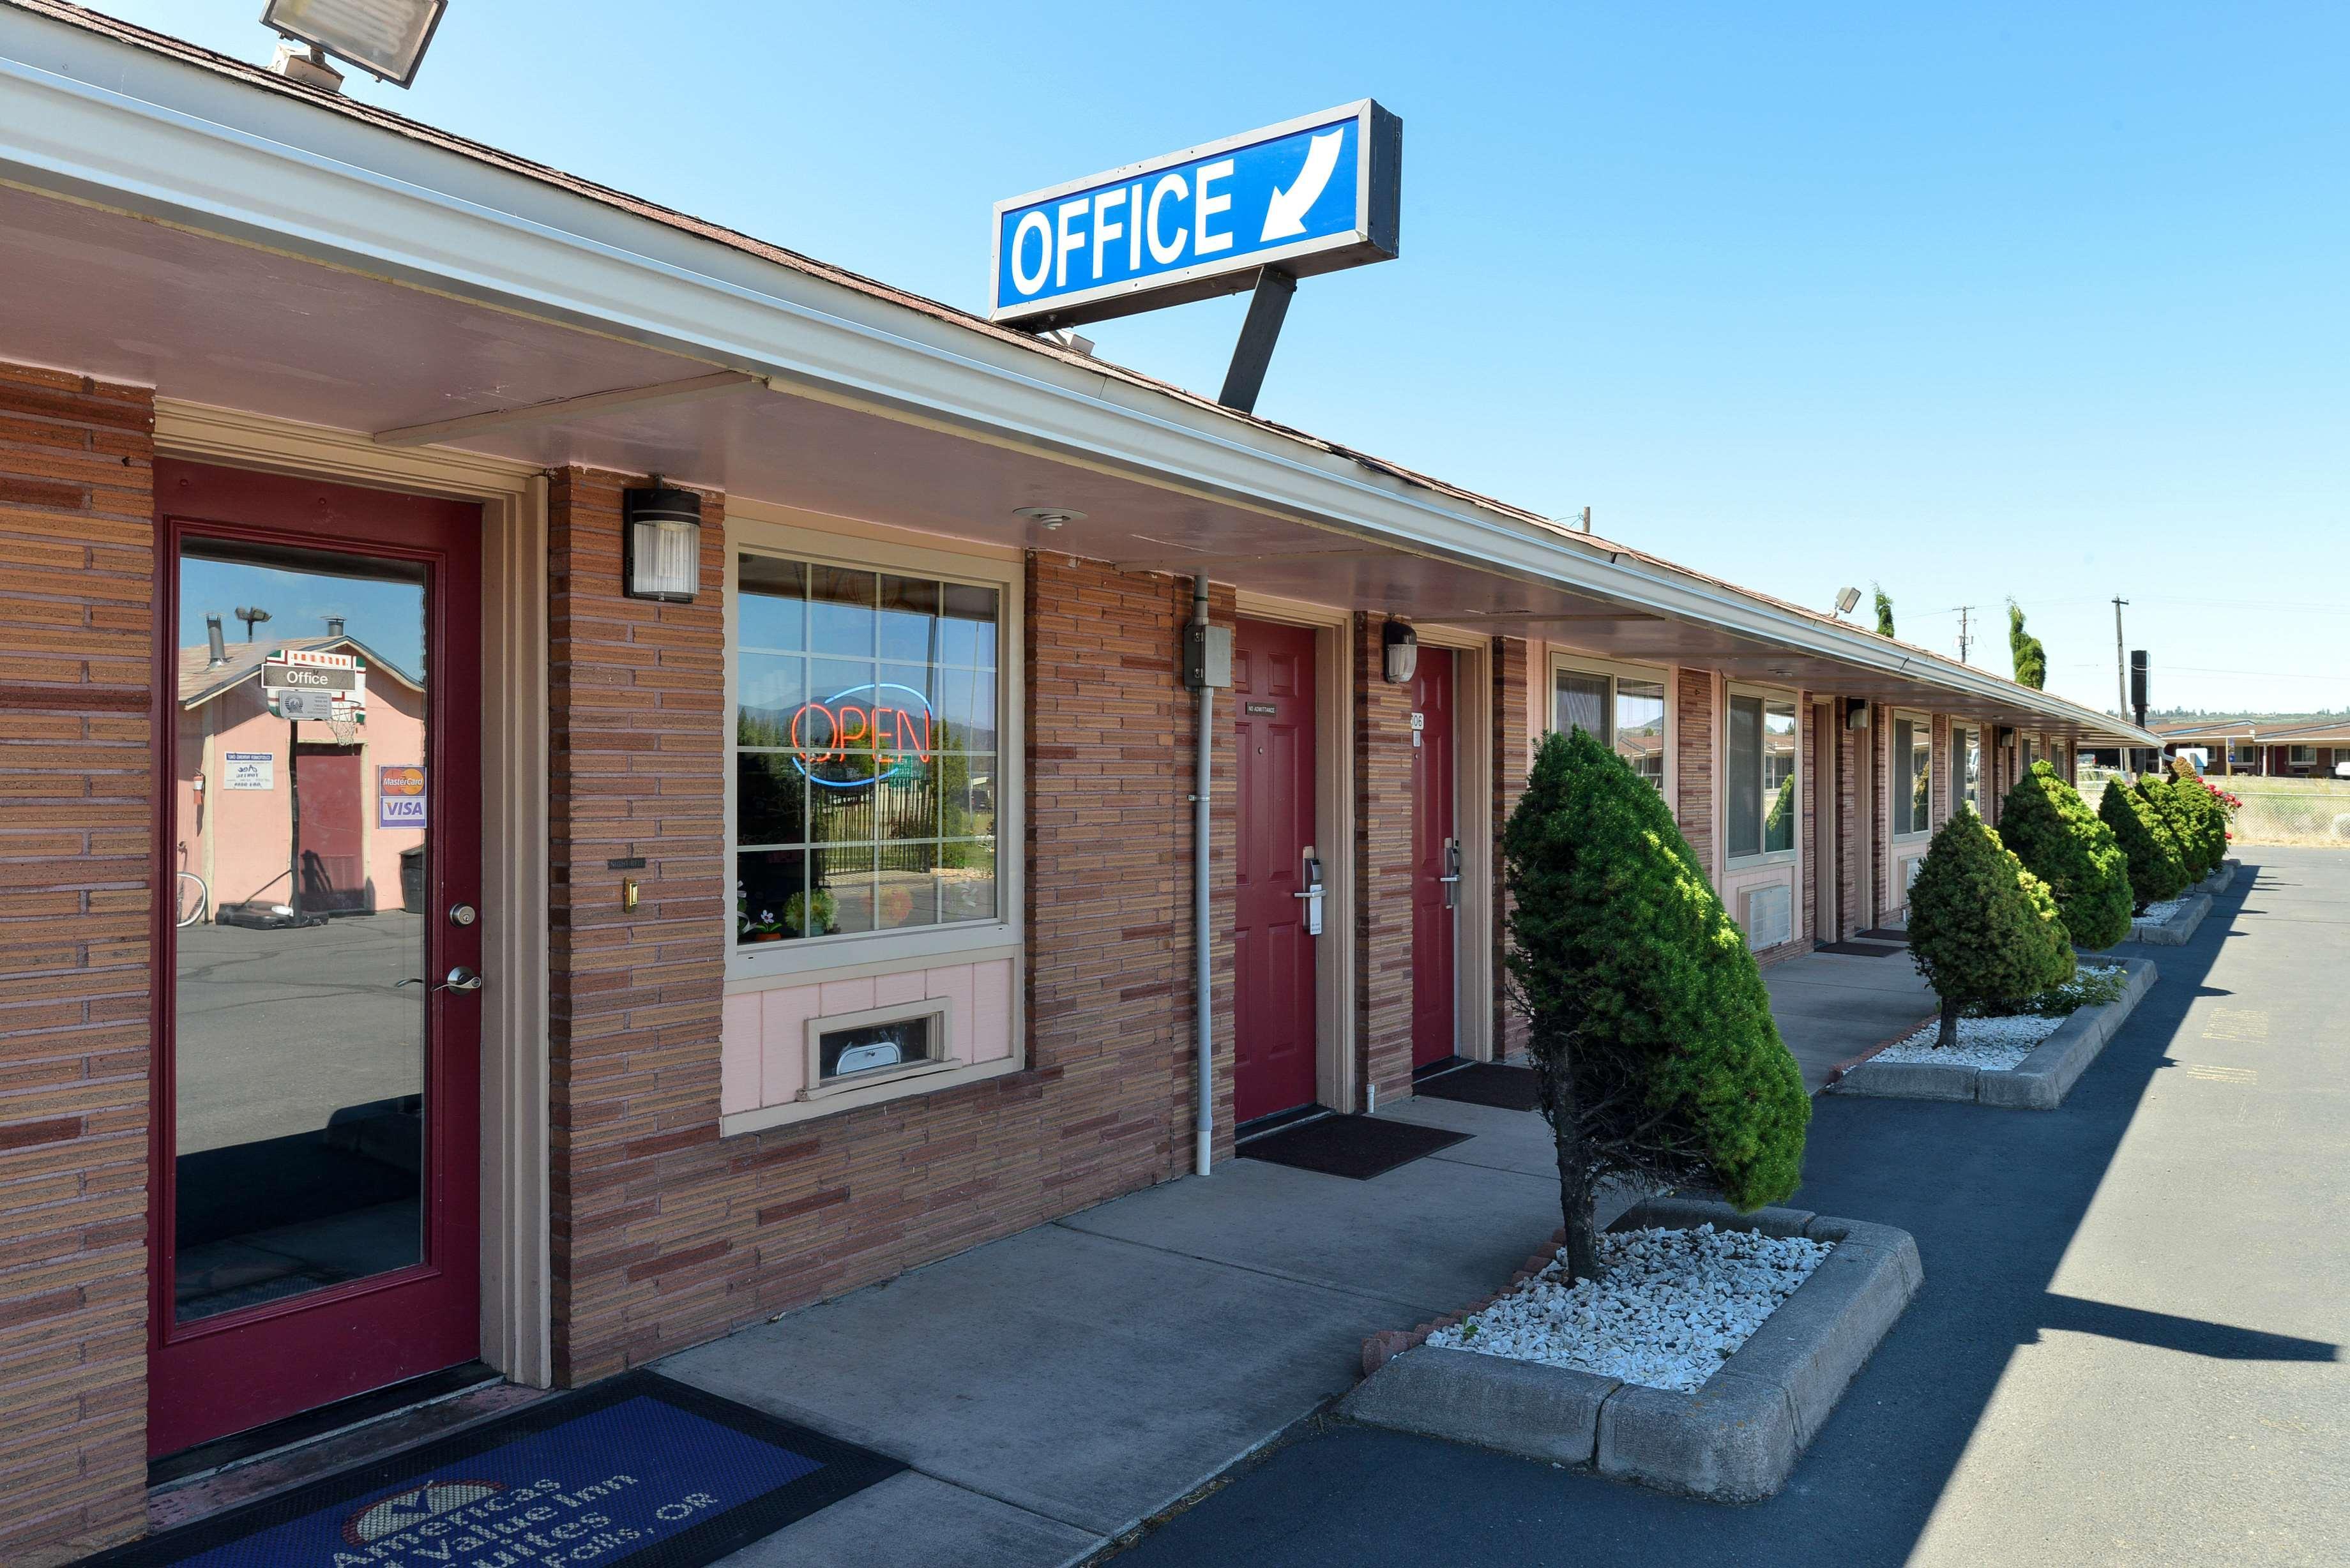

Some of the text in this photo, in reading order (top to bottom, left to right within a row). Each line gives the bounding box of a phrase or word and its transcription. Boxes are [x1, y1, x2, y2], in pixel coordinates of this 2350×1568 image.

[1012, 158, 1234, 294] OFFICE
[287, 671, 328, 684] Office
[791, 703, 930, 763] OPEN
[1411, 714, 1422, 727] 106
[383, 778, 423, 787] MasterCard
[384, 802, 423, 815] VISA
[334, 1479, 560, 1568] Americas
[414, 1475, 639, 1559] Value Inn
[656, 1491, 718, 1521] OR
[443, 1512, 611, 1568] uites
